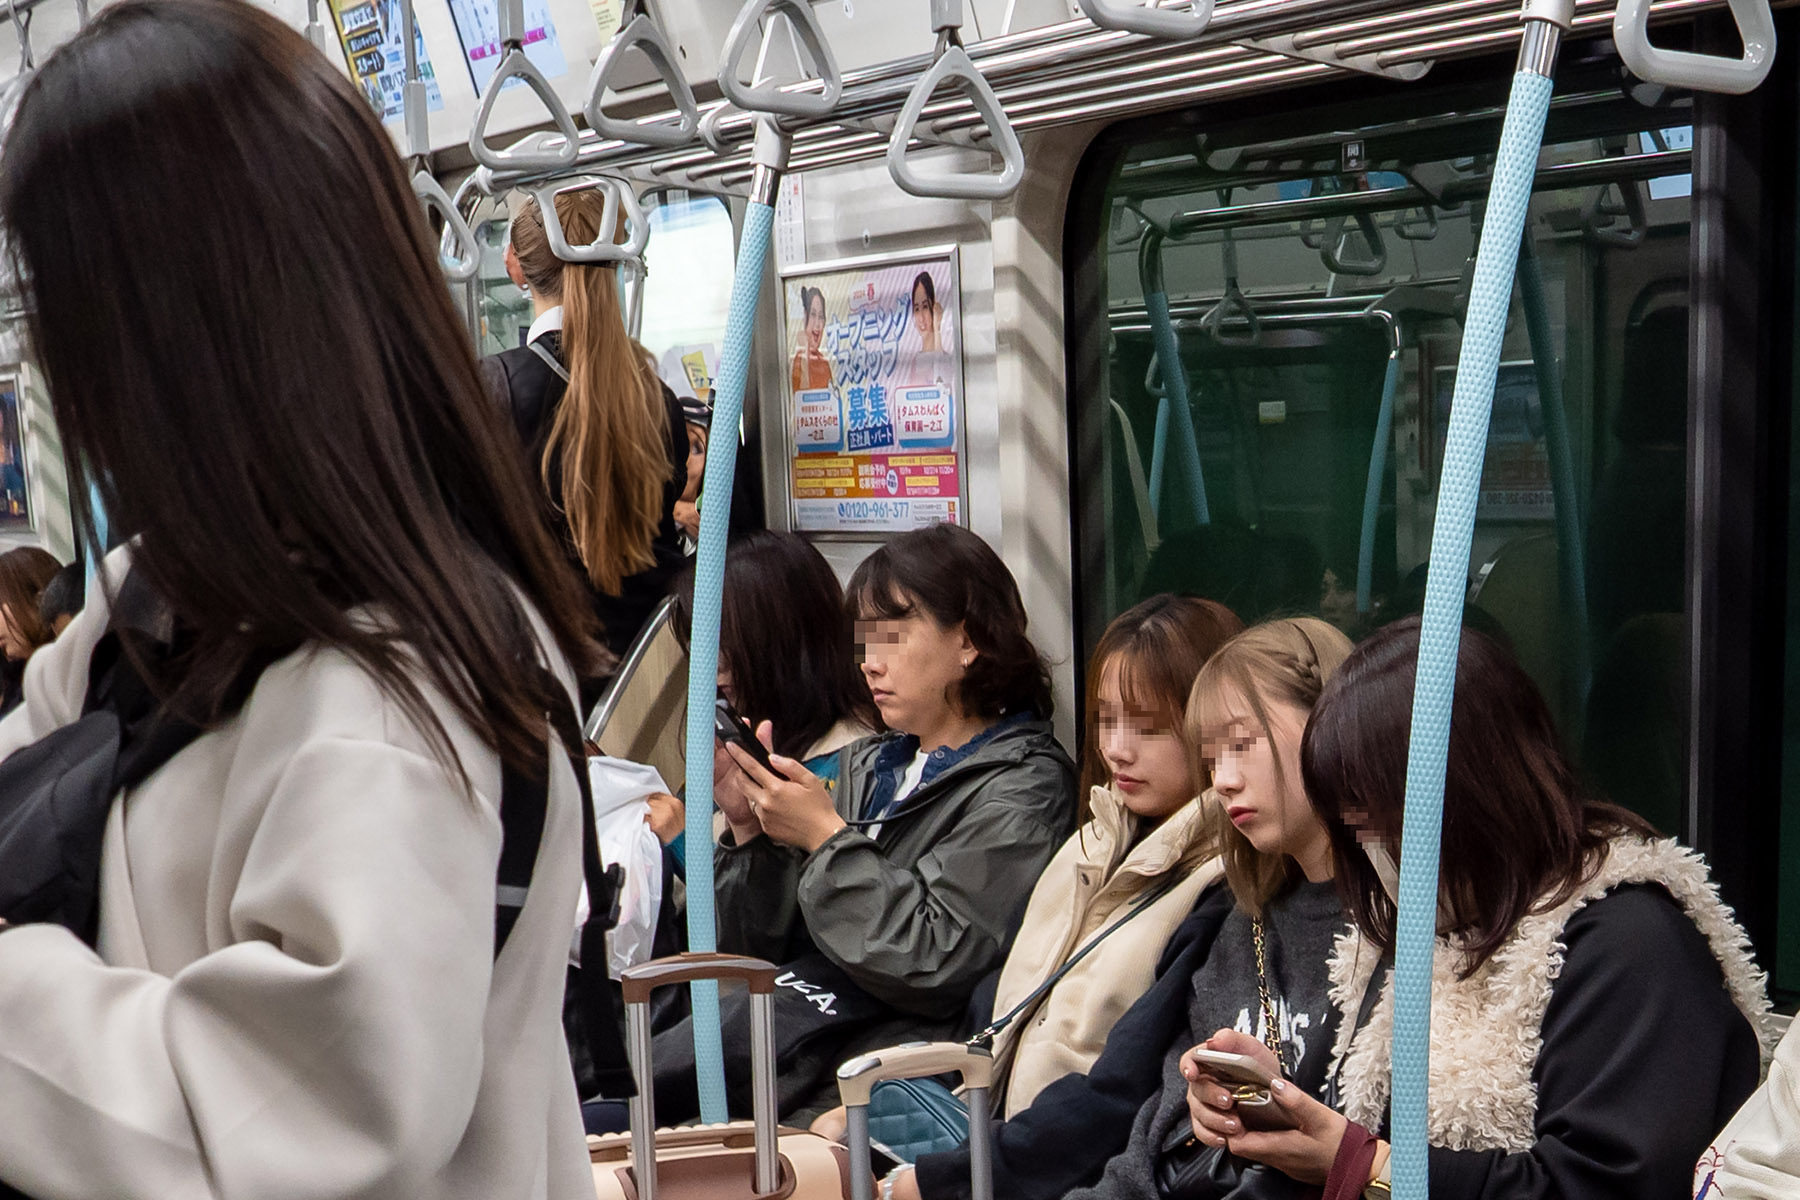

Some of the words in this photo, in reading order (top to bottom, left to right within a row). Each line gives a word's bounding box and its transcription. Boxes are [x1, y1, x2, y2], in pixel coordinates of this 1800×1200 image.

[826, 292, 912, 357] オープニング
[838, 339, 899, 388] スタッフ
[847, 382, 890, 432] 募集
[845, 501, 910, 519] 0120-961-377
